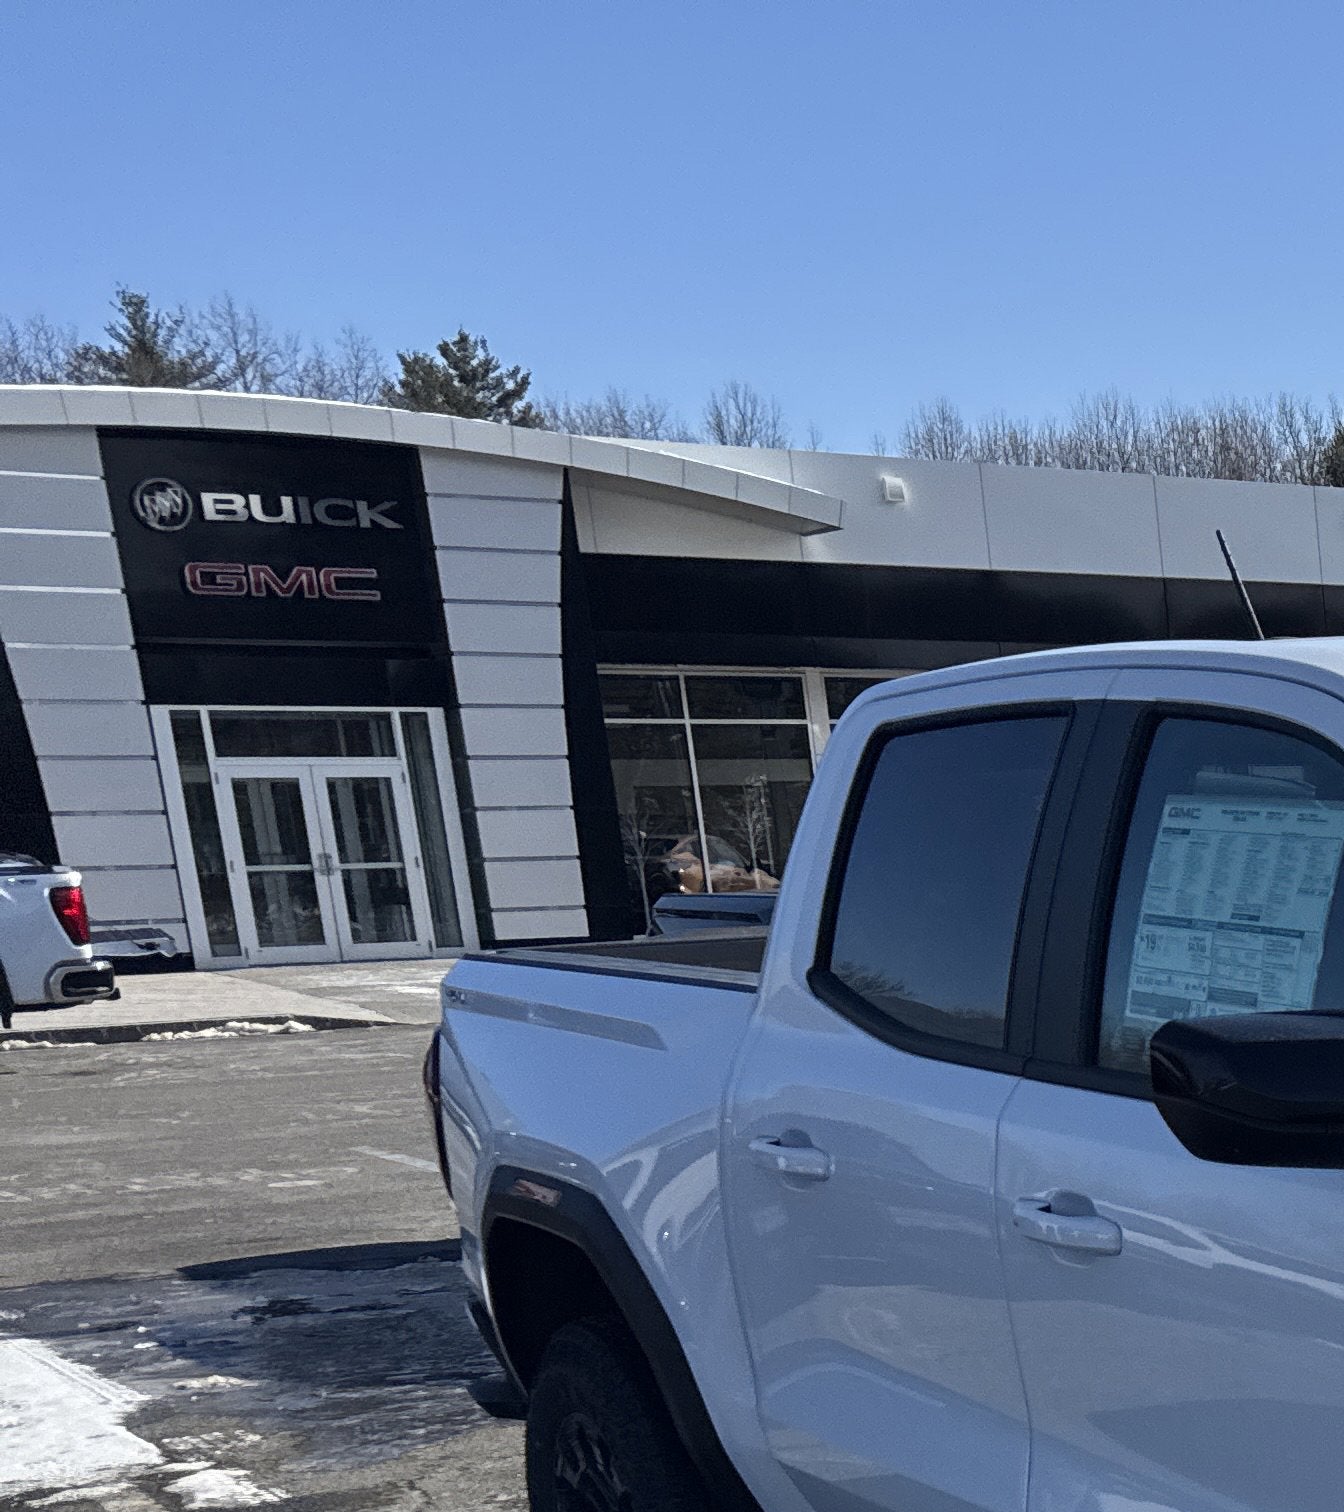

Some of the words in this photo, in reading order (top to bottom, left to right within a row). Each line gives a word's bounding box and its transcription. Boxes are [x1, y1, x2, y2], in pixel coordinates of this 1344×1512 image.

[201, 491, 404, 529] BUICK
[184, 561, 381, 601] GMC
[1167, 805, 1202, 821] GMC
